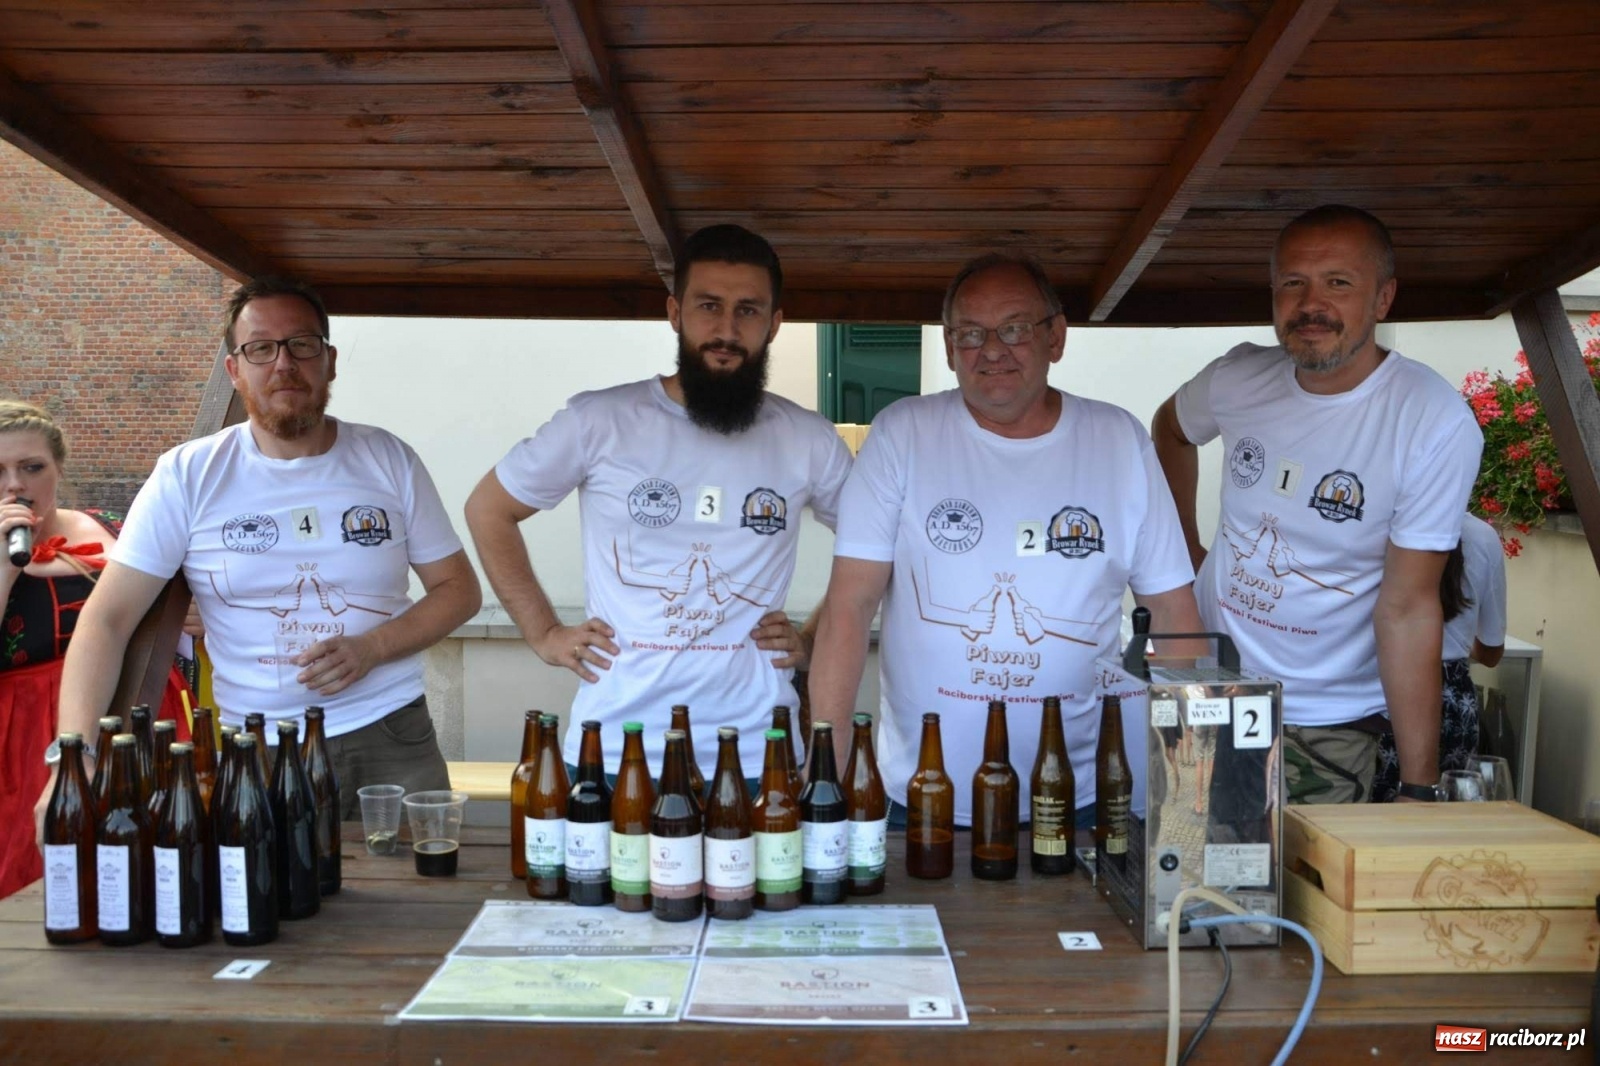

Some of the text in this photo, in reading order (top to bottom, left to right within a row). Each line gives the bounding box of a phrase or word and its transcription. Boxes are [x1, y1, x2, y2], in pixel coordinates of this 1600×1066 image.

[1279, 469, 1291, 491] 1
[700, 494, 715, 516] 3
[298, 514, 313, 534] 4
[956, 521, 980, 536] 1567
[1022, 529, 1036, 549] 2
[1051, 537, 1099, 549] Browar Rynek
[1230, 564, 1284, 600] Piwny
[1229, 585, 1276, 613] Fajer
[663, 603, 725, 624] Piwny
[277, 619, 345, 636] Piwny
[1247, 613, 1288, 632] Festiwal
[1291, 627, 1318, 636] Piwa
[631, 640, 684, 651] Raciborski
[966, 644, 1041, 669] Piwny
[970, 668, 1035, 690] Fajer
[937, 686, 997, 703] Raciborski
[1000, 694, 1044, 704] Festiwa
[1242, 709, 1260, 738] 2
[1069, 936, 1088, 947] 2
[514, 980, 602, 988] BASTION
[918, 1001, 938, 1014] 3
